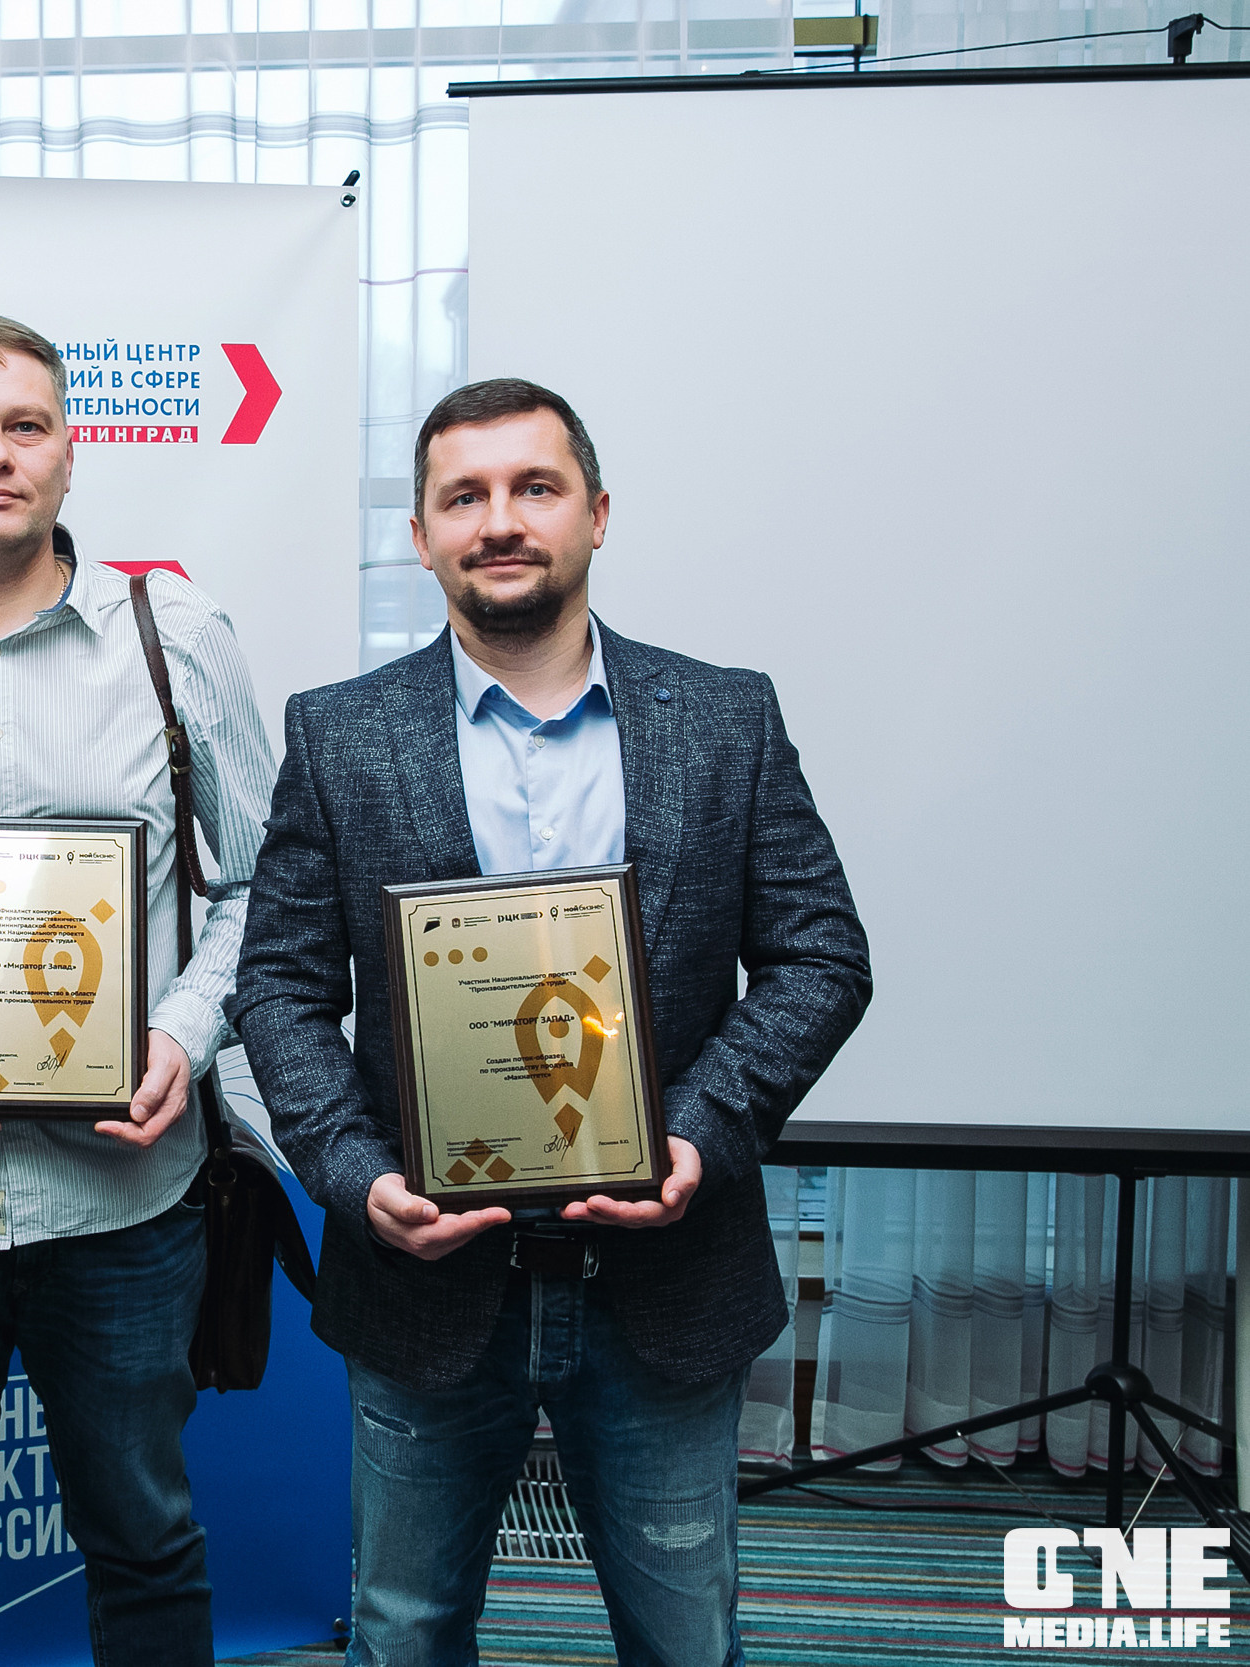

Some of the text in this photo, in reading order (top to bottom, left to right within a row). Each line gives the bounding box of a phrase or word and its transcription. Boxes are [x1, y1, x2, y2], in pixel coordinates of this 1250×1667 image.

[126, 343, 201, 365] ЦЕНТР
[111, 370, 124, 388] В
[130, 370, 201, 389] СФЕРЕ
[3, 962, 46, 970] «Мираторг
[458, 970, 577, 986] Участник Национального проекта
[469, 1021, 489, 1030] ООО
[486, 1057, 512, 1065] Создан
[490, 1064, 540, 1074] производству
[540, 1061, 574, 1070] продукта
